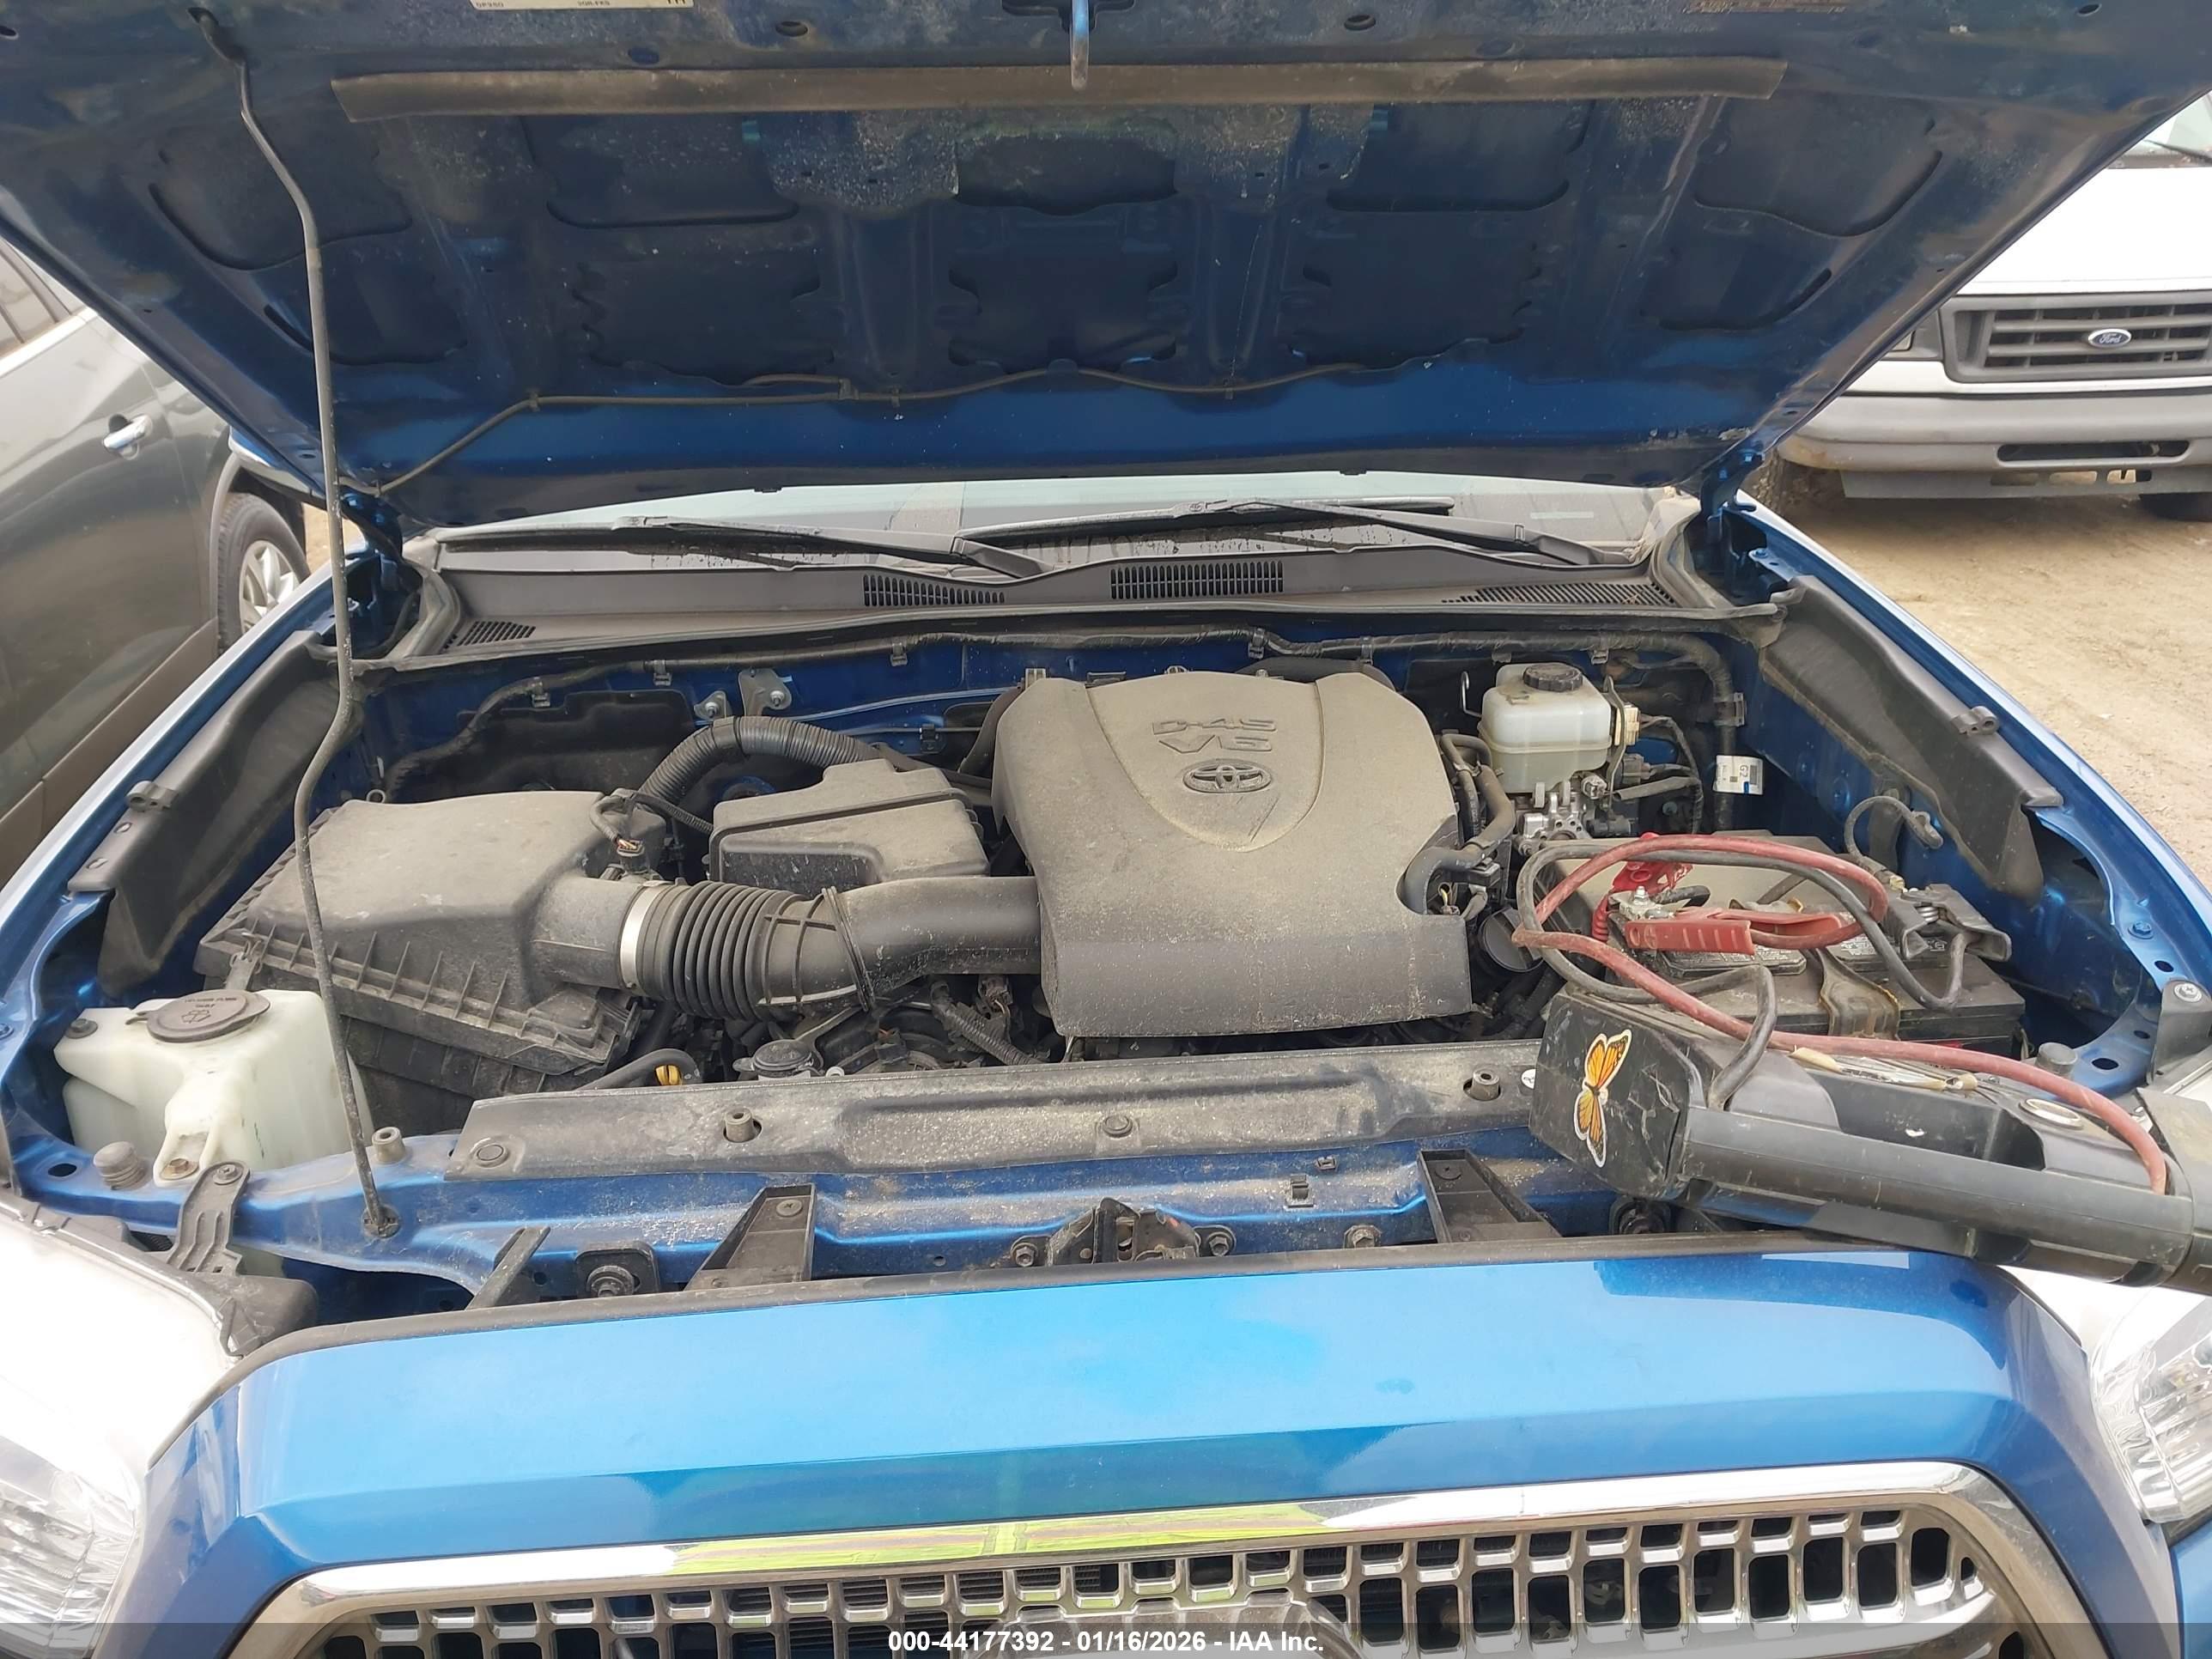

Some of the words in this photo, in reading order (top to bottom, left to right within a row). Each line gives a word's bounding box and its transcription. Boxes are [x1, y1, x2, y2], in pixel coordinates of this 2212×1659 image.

[2099, 332, 2123, 344] Ford
[1158, 734, 1273, 754] V6
[1739, 764, 1749, 778] G2
